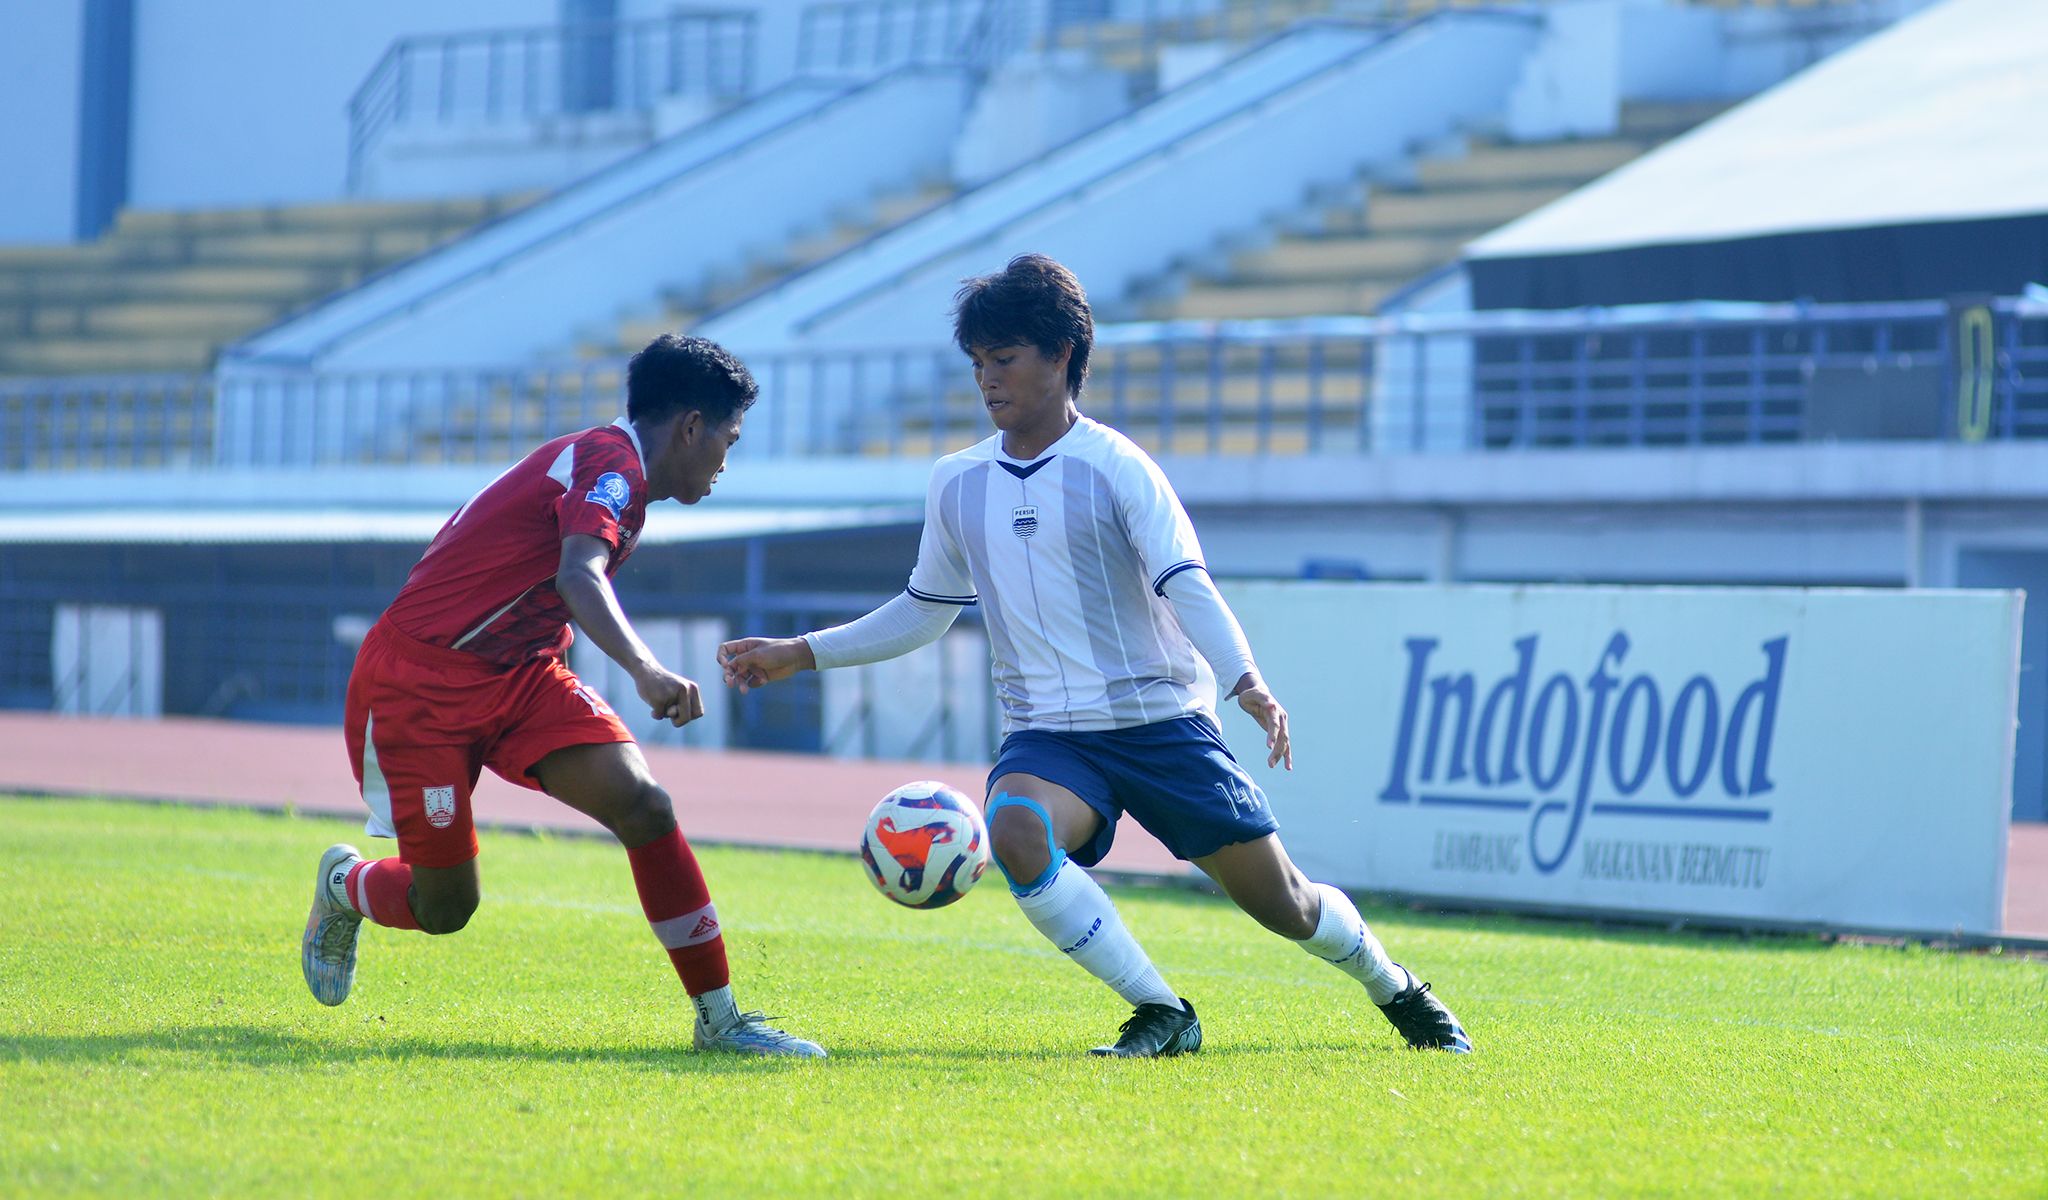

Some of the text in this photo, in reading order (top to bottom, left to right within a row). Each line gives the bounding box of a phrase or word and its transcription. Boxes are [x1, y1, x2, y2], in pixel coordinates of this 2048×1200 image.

[1377, 629, 1790, 875] Indofood
[1214, 775, 1256, 820] 14
[1431, 830, 1771, 890] LAMBANG MAKANAN BERMUTU
